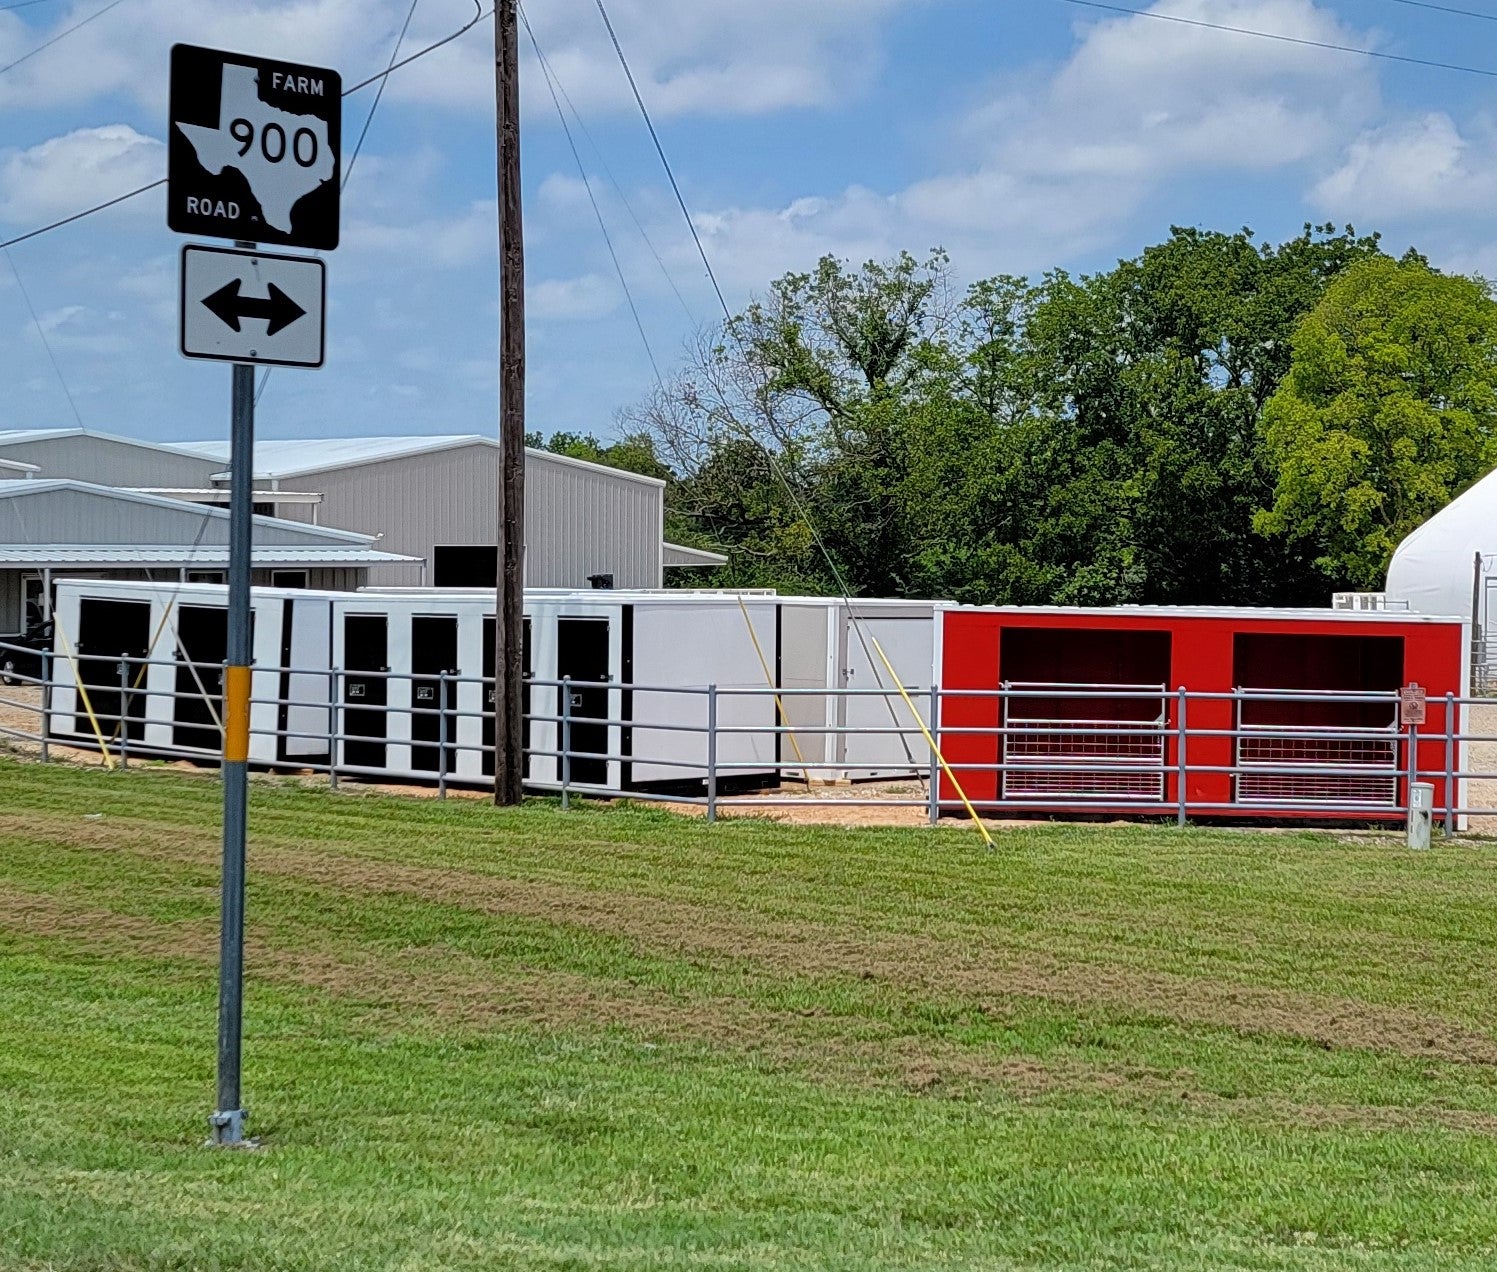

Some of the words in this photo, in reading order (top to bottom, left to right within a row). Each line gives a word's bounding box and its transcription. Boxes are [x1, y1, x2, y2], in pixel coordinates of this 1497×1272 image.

[272, 72, 324, 96] FARM
[229, 118, 318, 168] 900
[186, 196, 240, 219] ROAD
